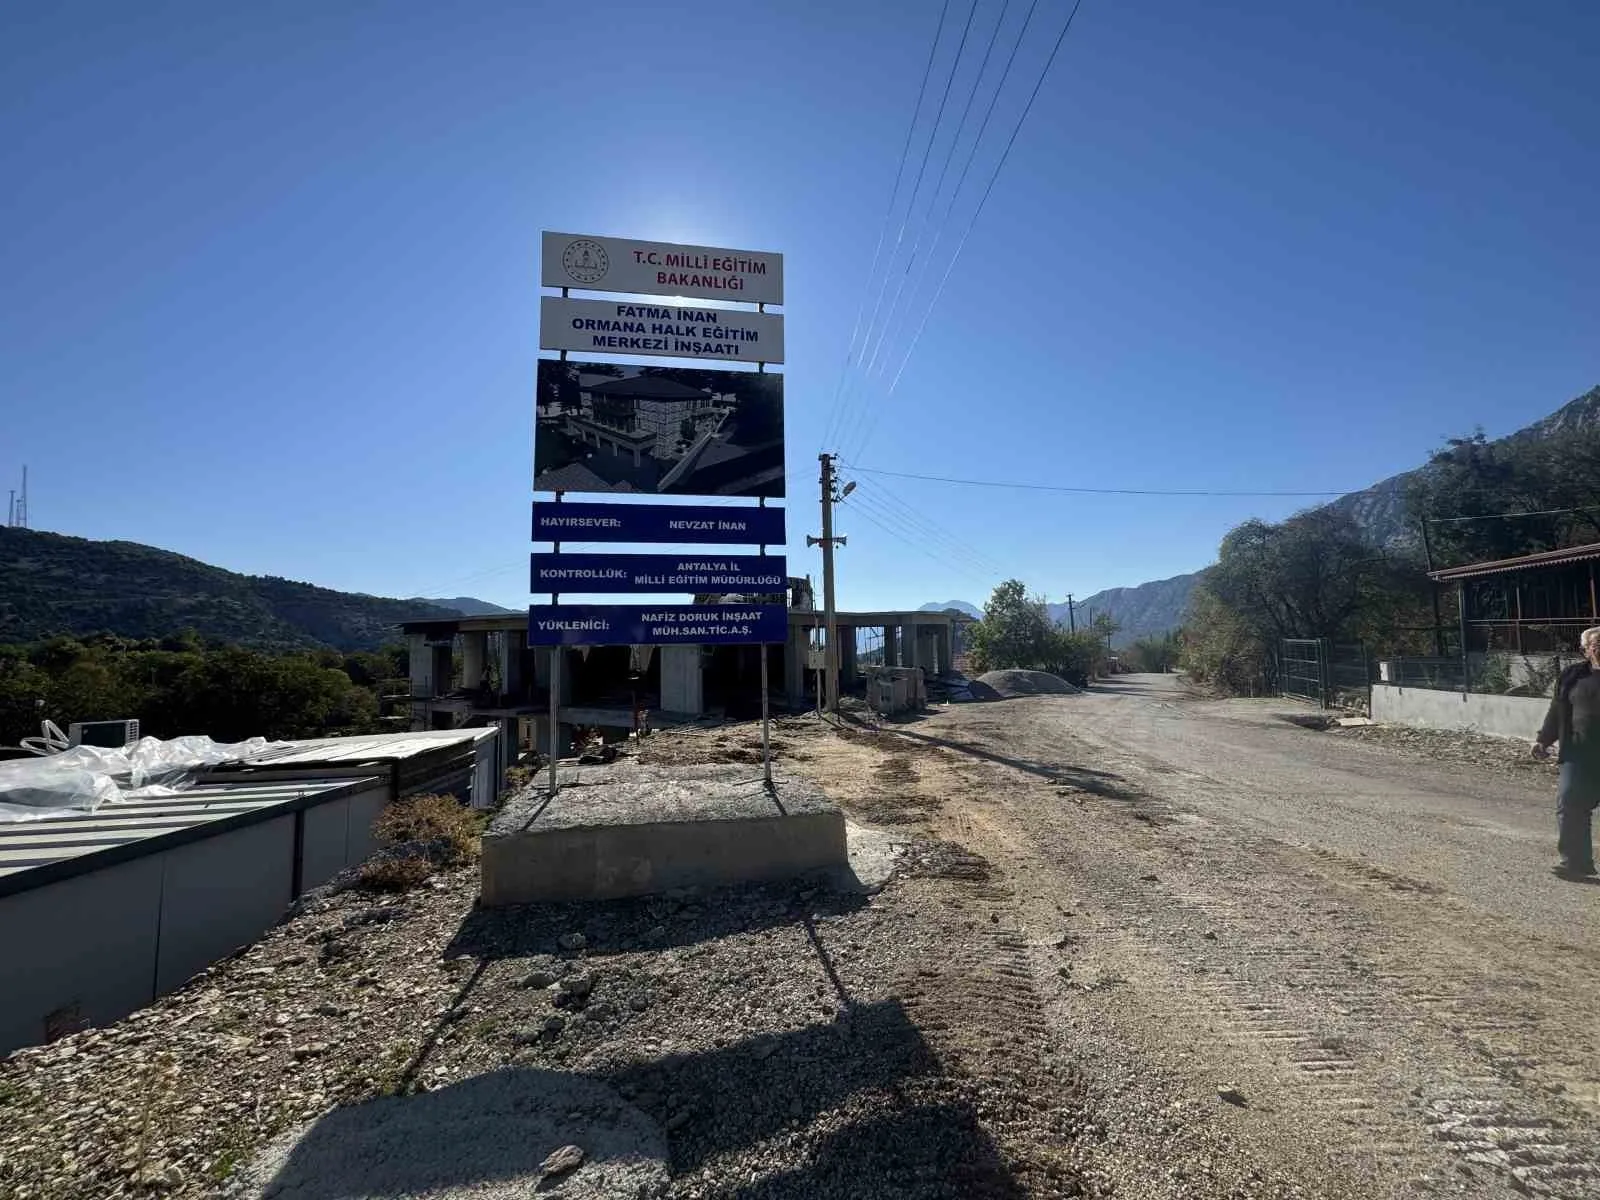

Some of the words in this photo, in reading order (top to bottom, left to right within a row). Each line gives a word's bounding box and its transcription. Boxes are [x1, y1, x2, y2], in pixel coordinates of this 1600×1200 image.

[633, 250, 661, 265] T.C.
[665, 253, 709, 270] MİLLİ
[712, 257, 766, 275] EĞİTİM
[656, 271, 744, 290] BAKANLIĞI
[616, 305, 672, 320] FATMA
[677, 306, 717, 323] İNAN
[572, 318, 646, 334] ORMANA
[651, 324, 697, 338] HALK
[702, 325, 759, 342] EĞİTİM
[593, 334, 669, 351] MERKEZİ
[674, 337, 739, 355] İNŞAATI
[540, 517, 621, 527] HAYIRSEVER:
[669, 520, 714, 530] NEVZAT
[718, 519, 746, 530] İNAN
[677, 562, 727, 571] ANTALYA
[730, 560, 740, 571] İL
[540, 568, 627, 578] KONTROLLÜK:
[635, 574, 665, 584] MİLLİ
[668, 574, 708, 584] EĞİTİM
[711, 574, 781, 585] MÜDÜRLÜĞÜ
[641, 611, 675, 622] NAFİZ
[679, 612, 718, 622] DORUK
[722, 611, 762, 623] İNŞAAT
[538, 618, 610, 631] YÜKLENİCİ:
